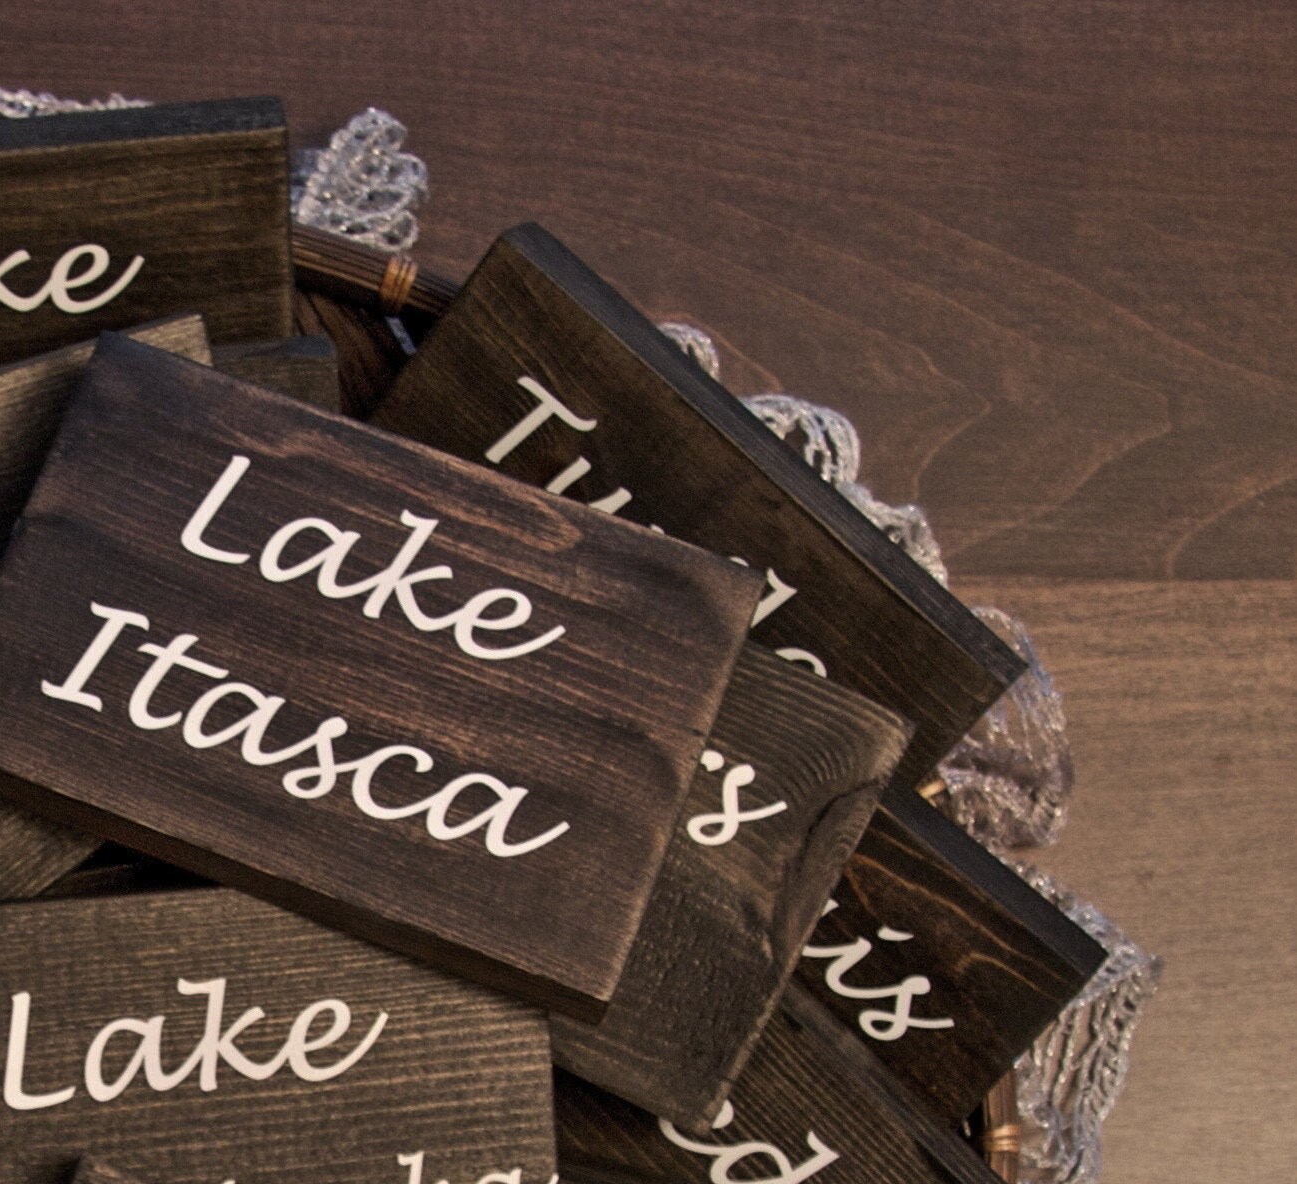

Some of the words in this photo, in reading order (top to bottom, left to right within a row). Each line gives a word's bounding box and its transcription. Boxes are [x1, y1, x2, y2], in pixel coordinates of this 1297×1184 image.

[178, 455, 566, 661] Lake
[40, 601, 570, 858] Itasca
[2, 977, 390, 1111] Lake
